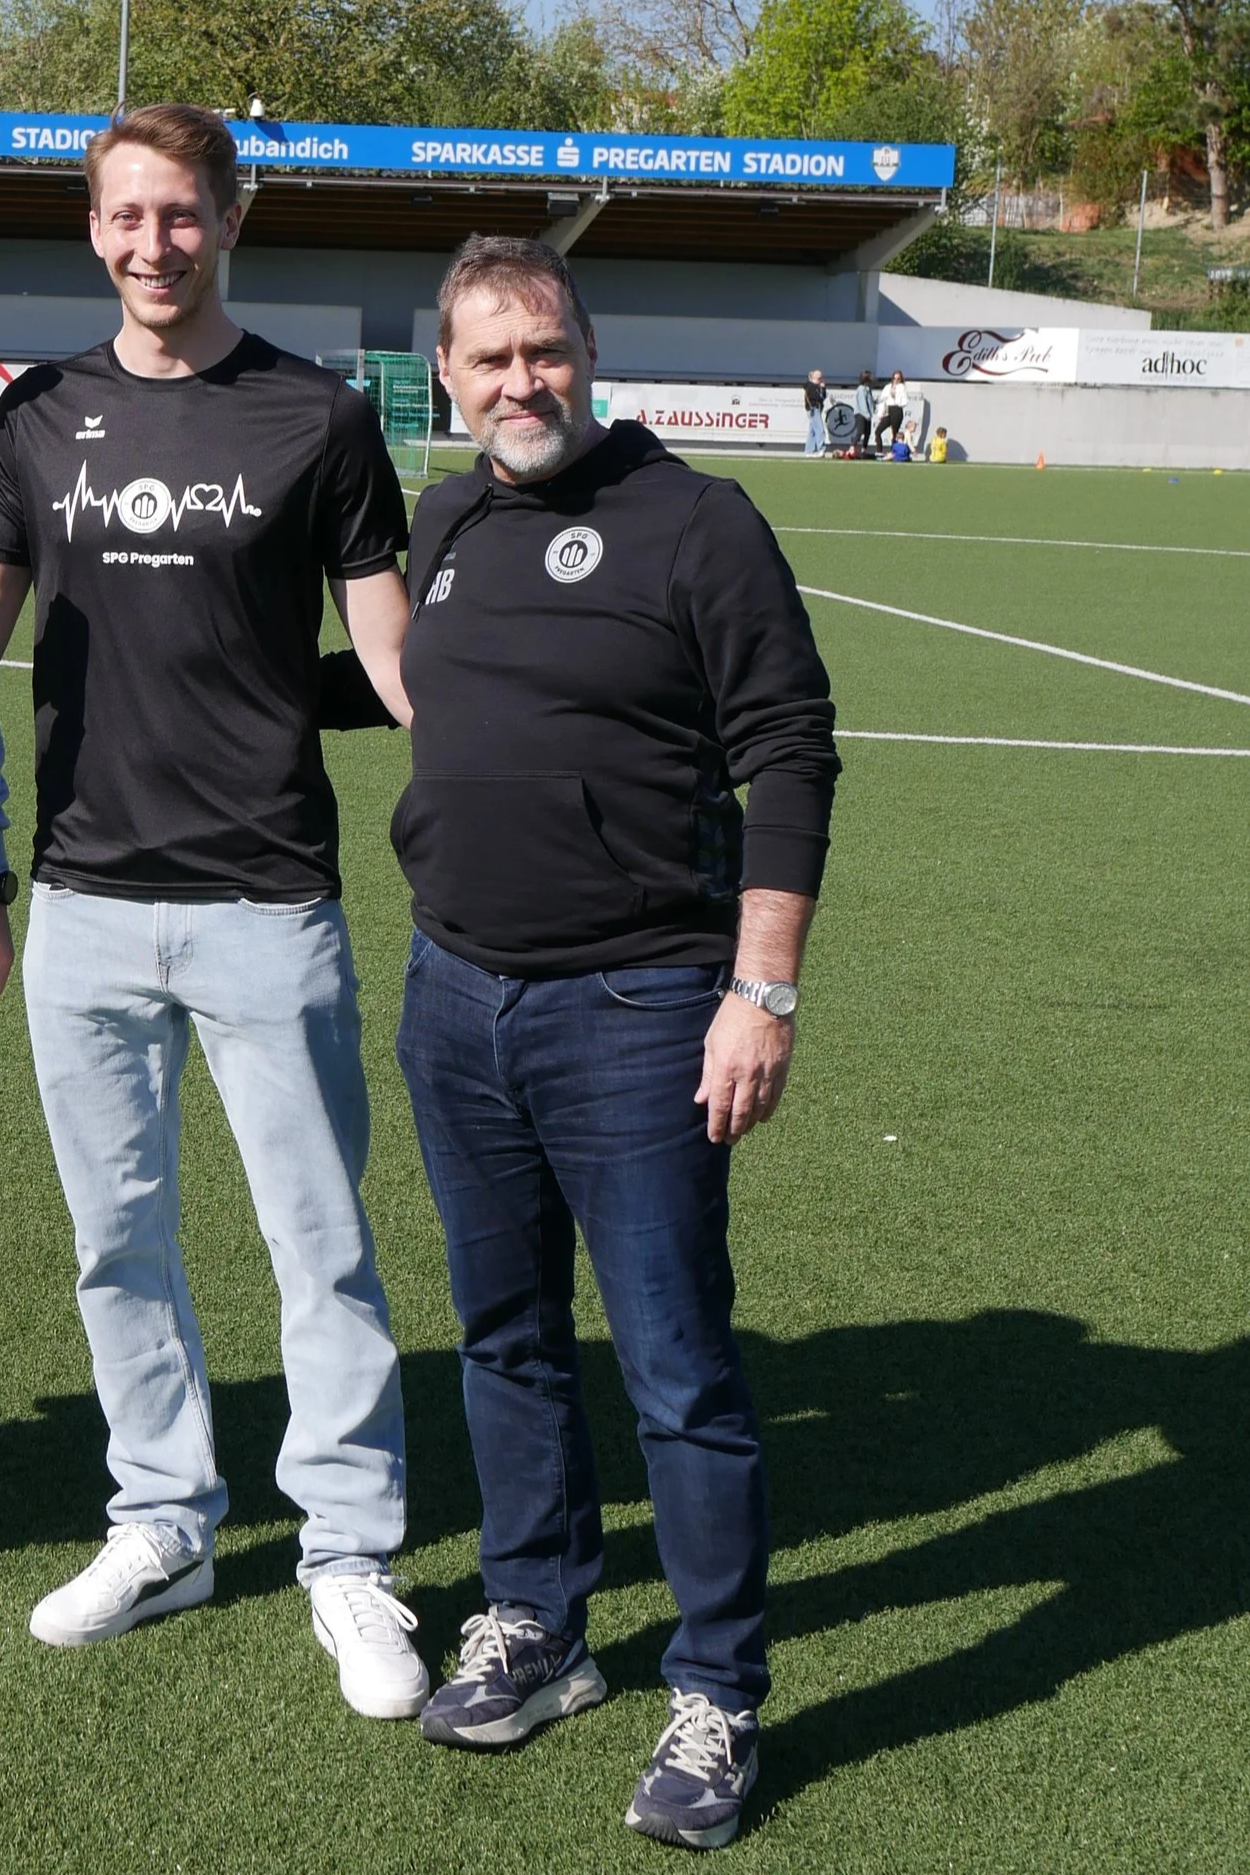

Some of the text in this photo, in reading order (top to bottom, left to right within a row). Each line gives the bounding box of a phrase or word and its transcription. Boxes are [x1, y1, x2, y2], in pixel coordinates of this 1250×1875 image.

[11, 127, 103, 151] STADIO
[236, 135, 349, 159] ubandich
[411, 141, 844, 177] SPARKASSE PREGARTEN STADION
[75, 429, 106, 440] erima
[102, 551, 194, 568] SPG Pregarten
